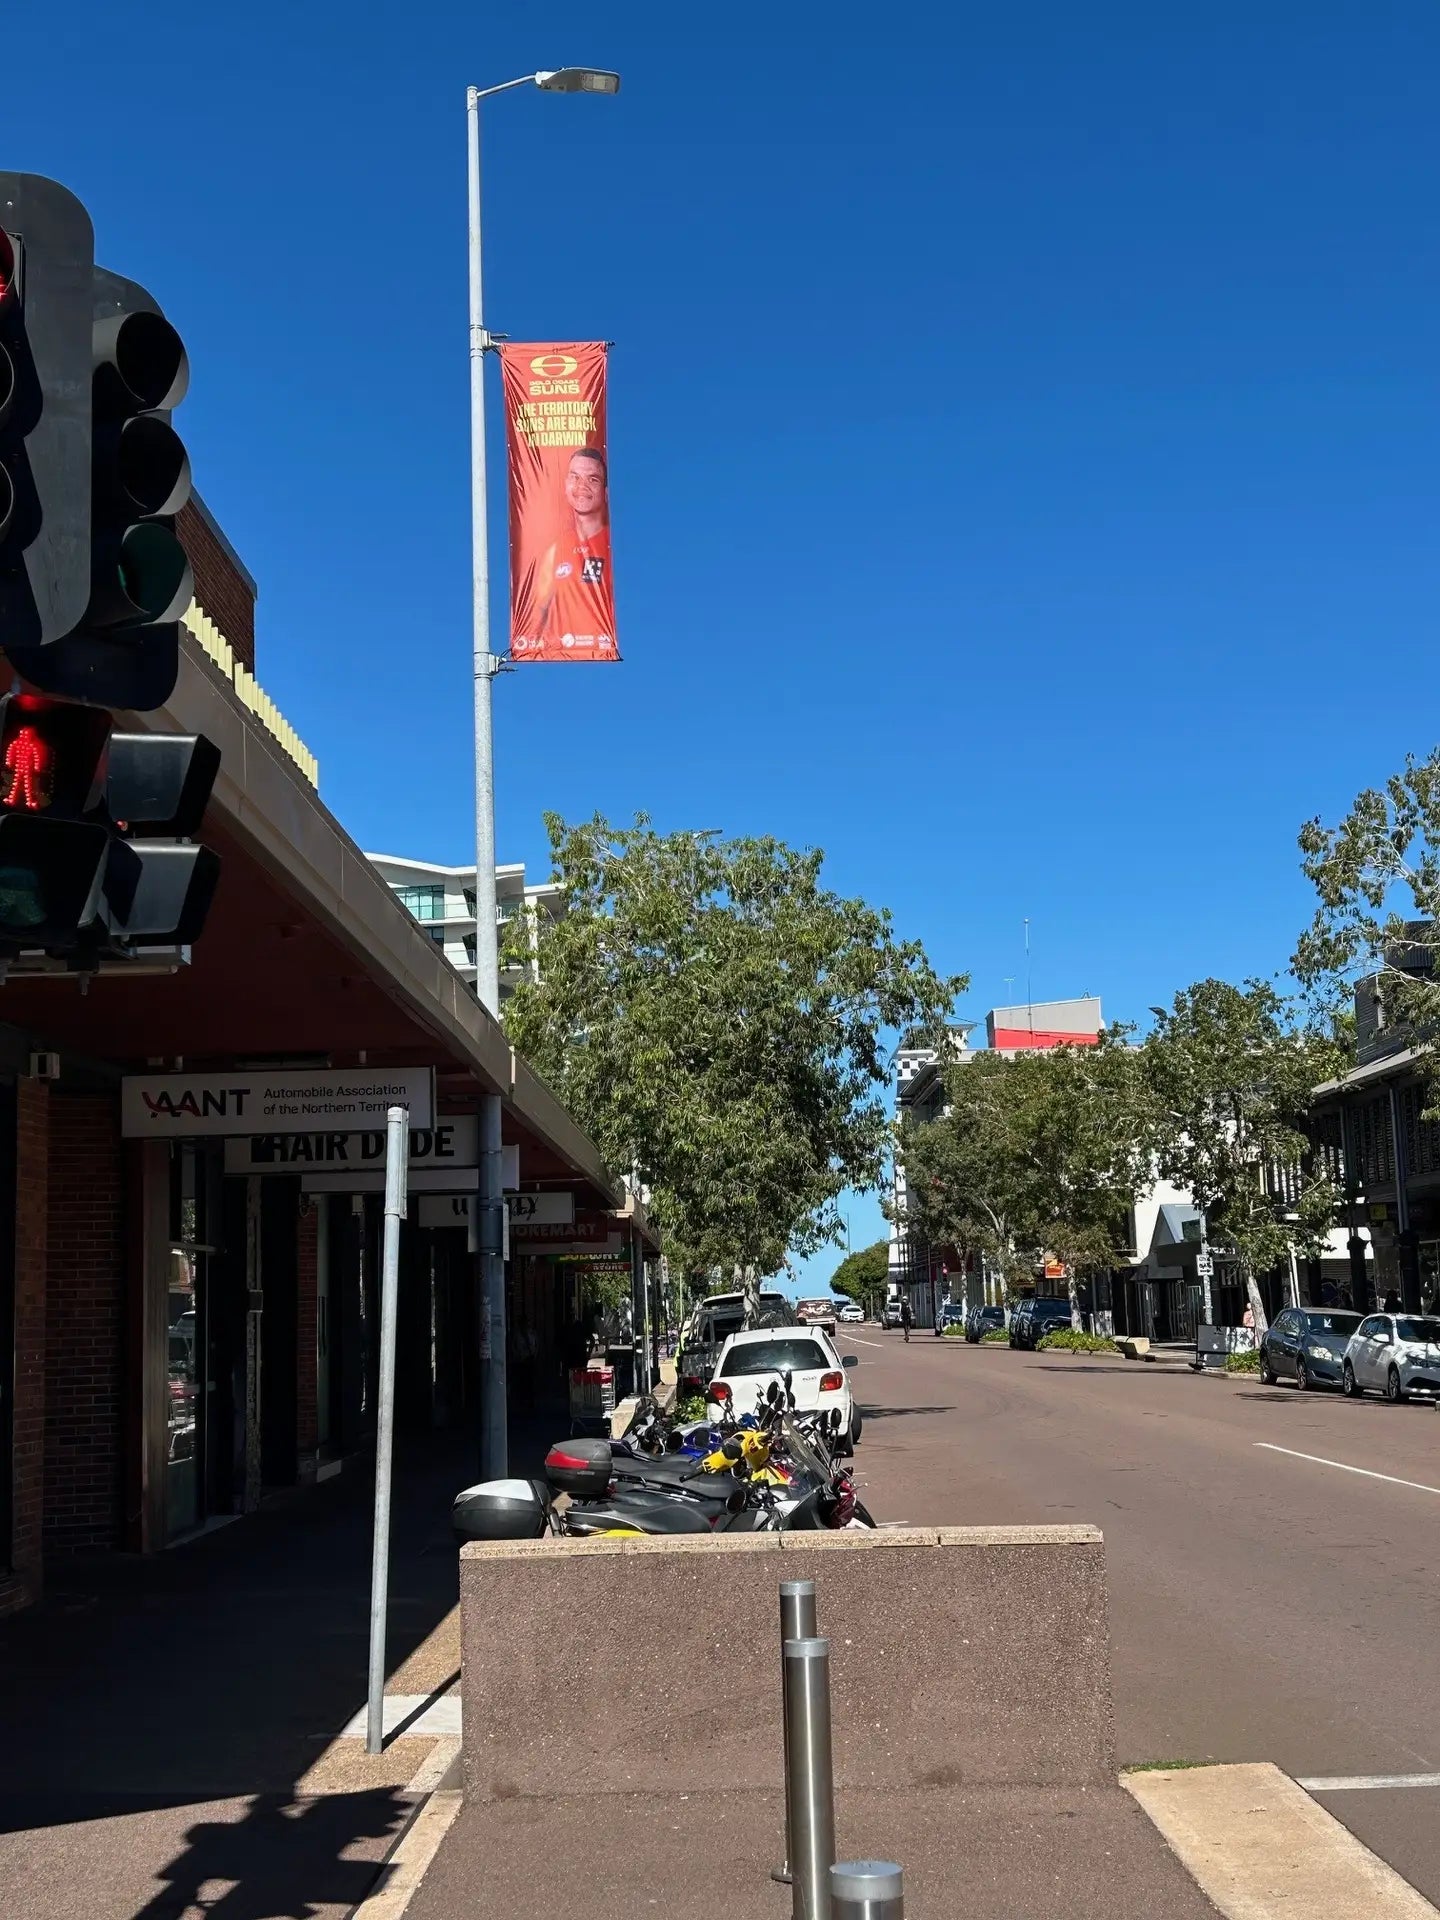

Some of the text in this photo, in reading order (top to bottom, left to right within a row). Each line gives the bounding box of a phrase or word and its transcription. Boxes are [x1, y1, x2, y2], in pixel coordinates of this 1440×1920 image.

[529, 384, 580, 396] SUNS
[519, 402, 593, 416] THE TERRITORY
[516, 417, 596, 432] SUNS ARE BACK
[541, 431, 586, 446] DARWIN
[263, 1084, 407, 1099] Automobile Association
[142, 1088, 251, 1118] AANT
[263, 1103, 276, 1115] of
[279, 1103, 299, 1114] the
[302, 1102, 356, 1114] Northern
[362, 1126, 455, 1160] DDE
